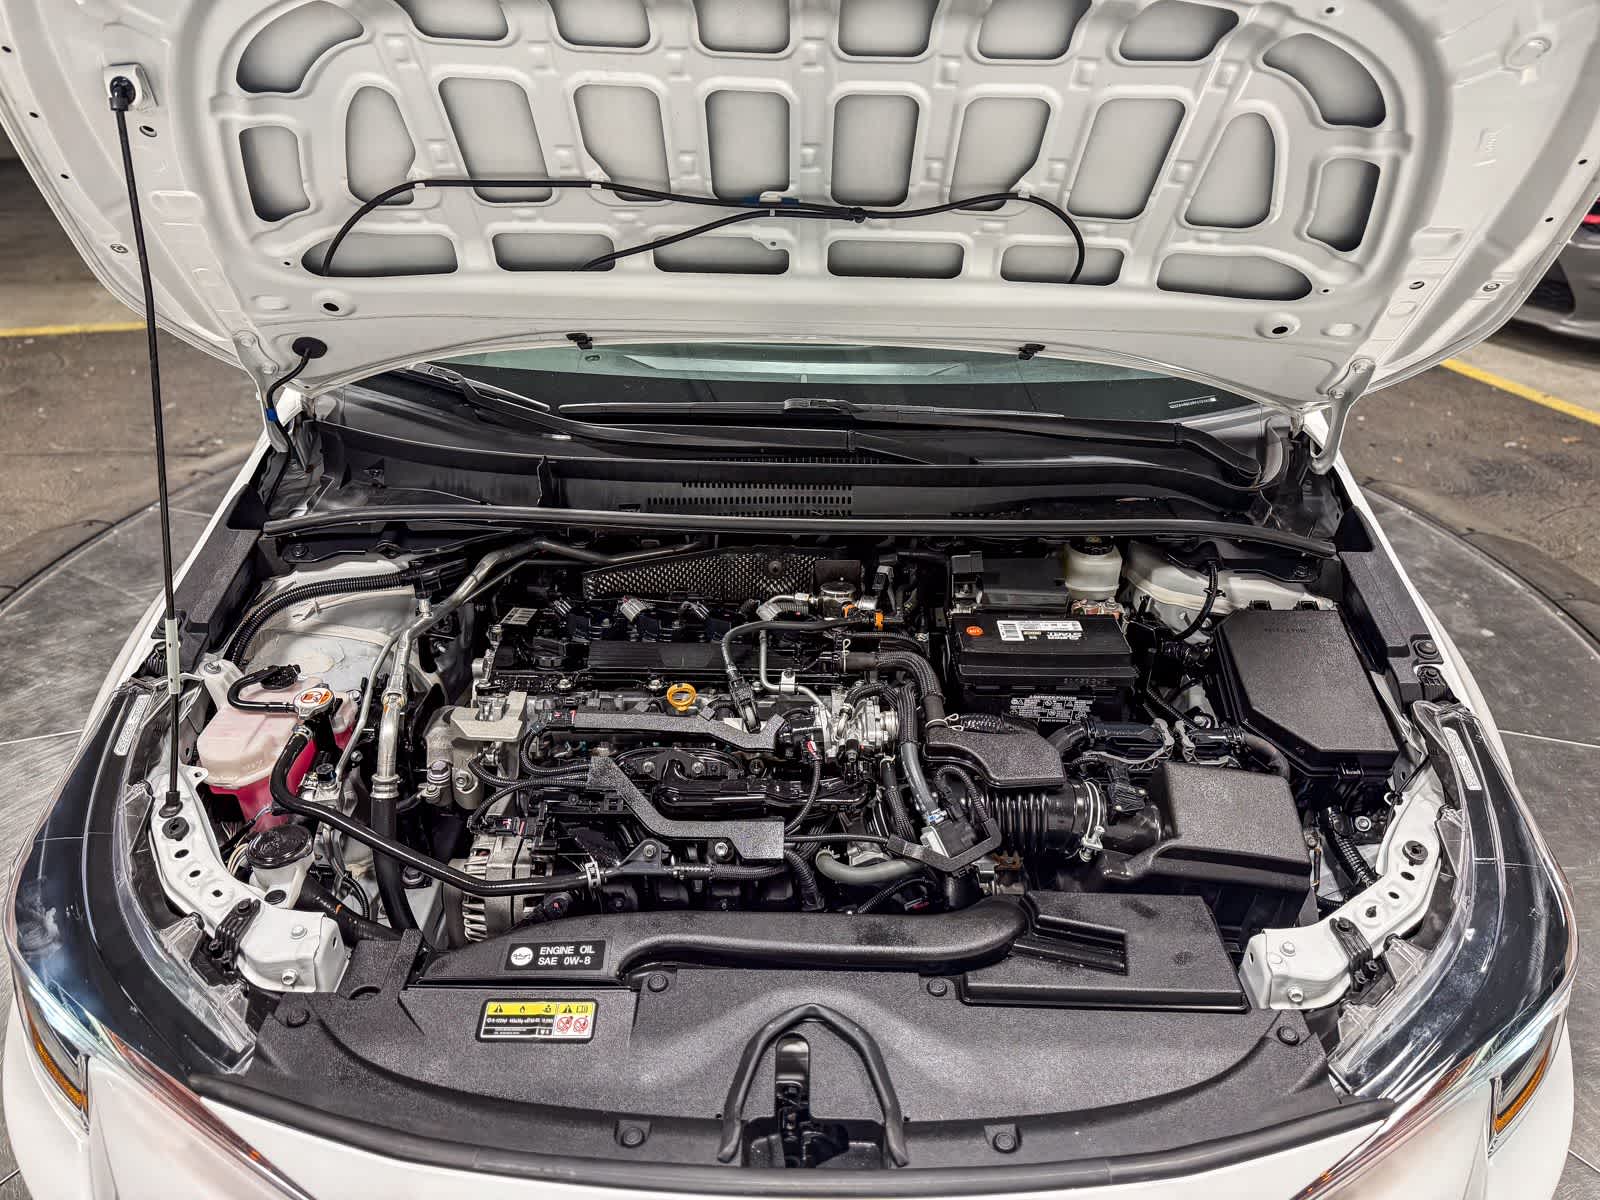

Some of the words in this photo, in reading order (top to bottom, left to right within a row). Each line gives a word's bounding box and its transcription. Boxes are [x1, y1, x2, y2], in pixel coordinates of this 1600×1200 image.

[540, 946, 574, 955] ENGINE
[579, 945, 595, 954] OIL
[537, 957, 558, 965] SAE
[564, 956, 591, 965] 0W-8
